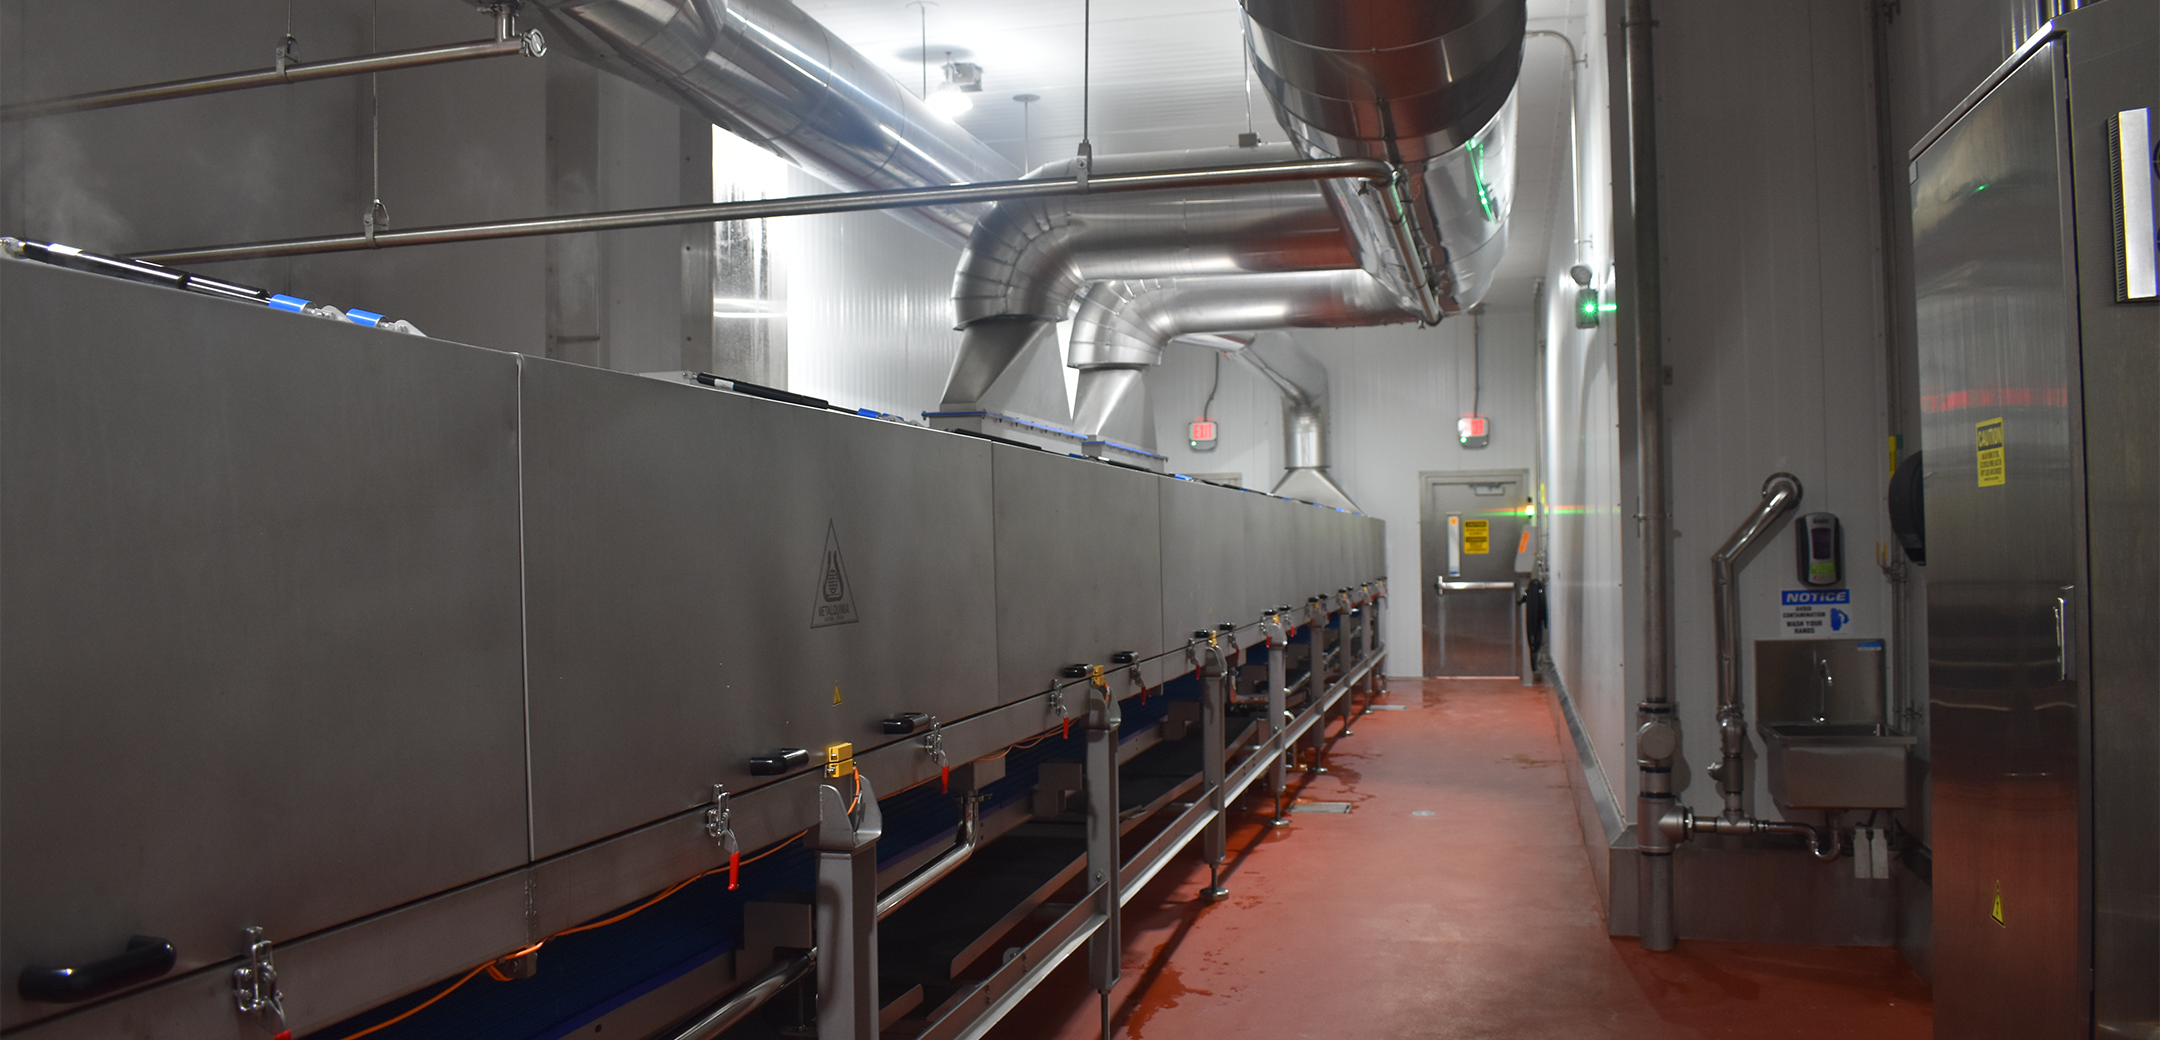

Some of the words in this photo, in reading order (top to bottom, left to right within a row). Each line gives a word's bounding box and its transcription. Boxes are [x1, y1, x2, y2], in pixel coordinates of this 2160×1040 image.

[1193, 423, 1213, 439] EXIT
[1978, 426, 2003, 448] CAUTION
[1786, 591, 1847, 603] NOTICE
